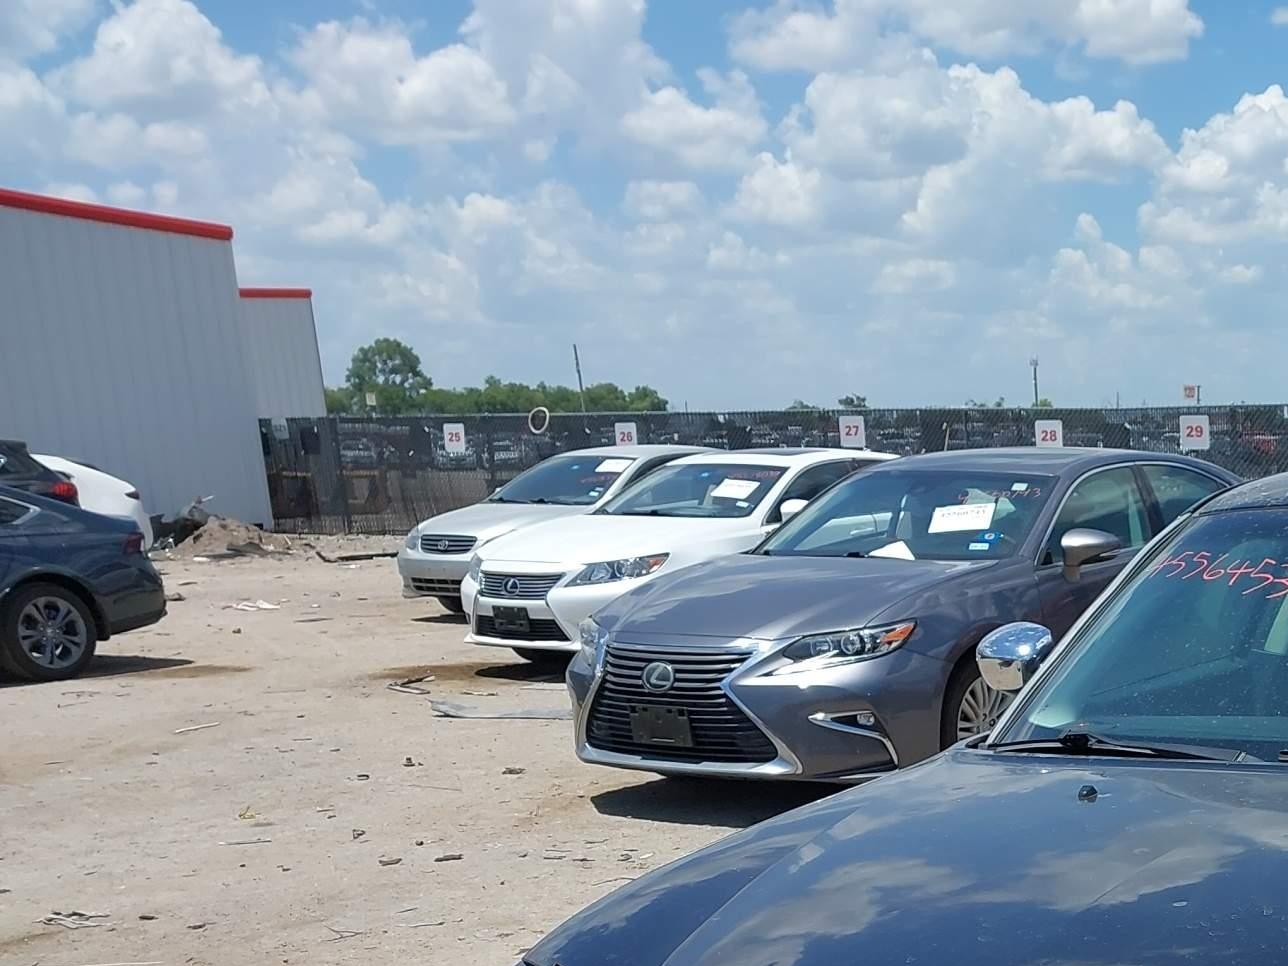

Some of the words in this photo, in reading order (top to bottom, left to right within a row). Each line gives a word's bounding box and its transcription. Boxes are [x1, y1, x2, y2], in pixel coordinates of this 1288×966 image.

[448, 431, 461, 442] 25
[619, 431, 633, 442] 26
[845, 425, 859, 437] 27
[1041, 430, 1057, 442] 28
[1186, 425, 1204, 438] 29
